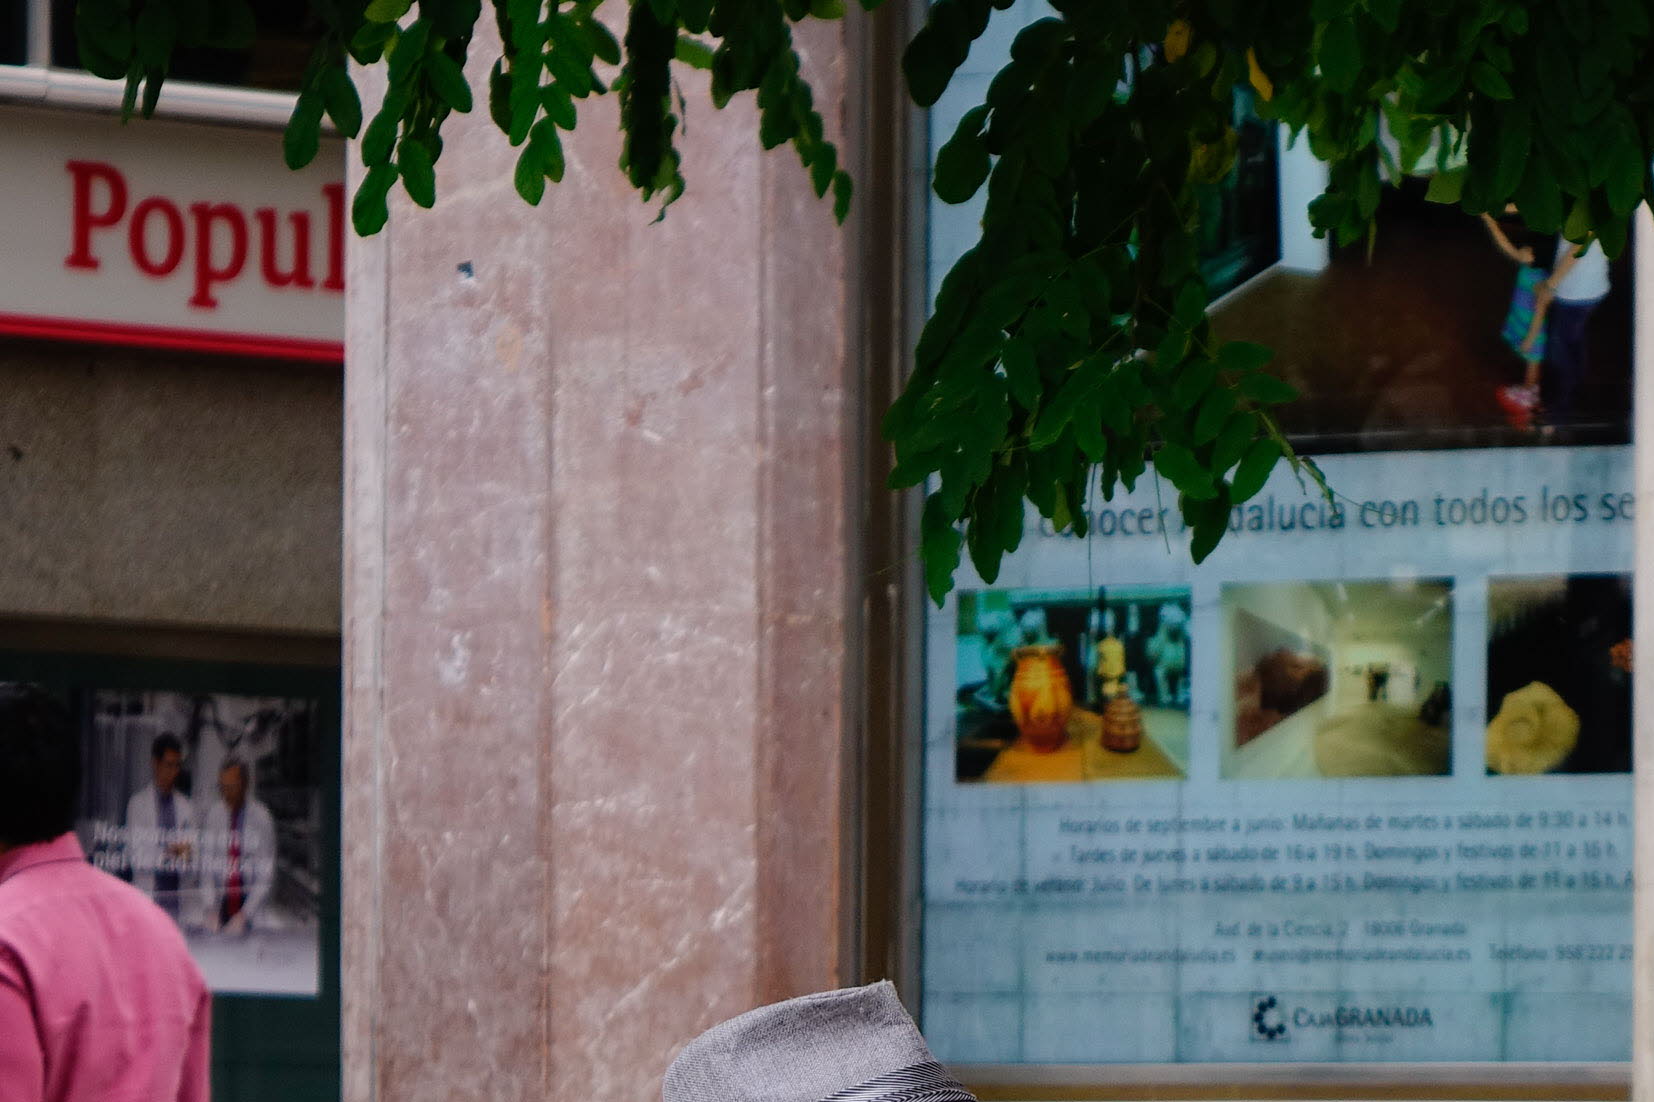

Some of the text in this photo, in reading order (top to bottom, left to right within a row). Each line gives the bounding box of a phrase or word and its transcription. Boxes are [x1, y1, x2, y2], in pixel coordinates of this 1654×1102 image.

[64, 158, 345, 310] Popul
[1039, 507, 1171, 536] nocer
[1360, 498, 1420, 528] con
[1434, 490, 1529, 526] todos
[1541, 488, 1590, 523] los
[1600, 492, 1635, 521] se
[1126, 816, 1142, 832] de
[1364, 813, 1382, 829] de
[1516, 811, 1533, 828] de
[1121, 845, 1137, 861] de
[1261, 844, 1279, 860] de
[1519, 842, 1537, 858] de
[1270, 874, 1287, 891] de
[1518, 872, 1536, 888] de
